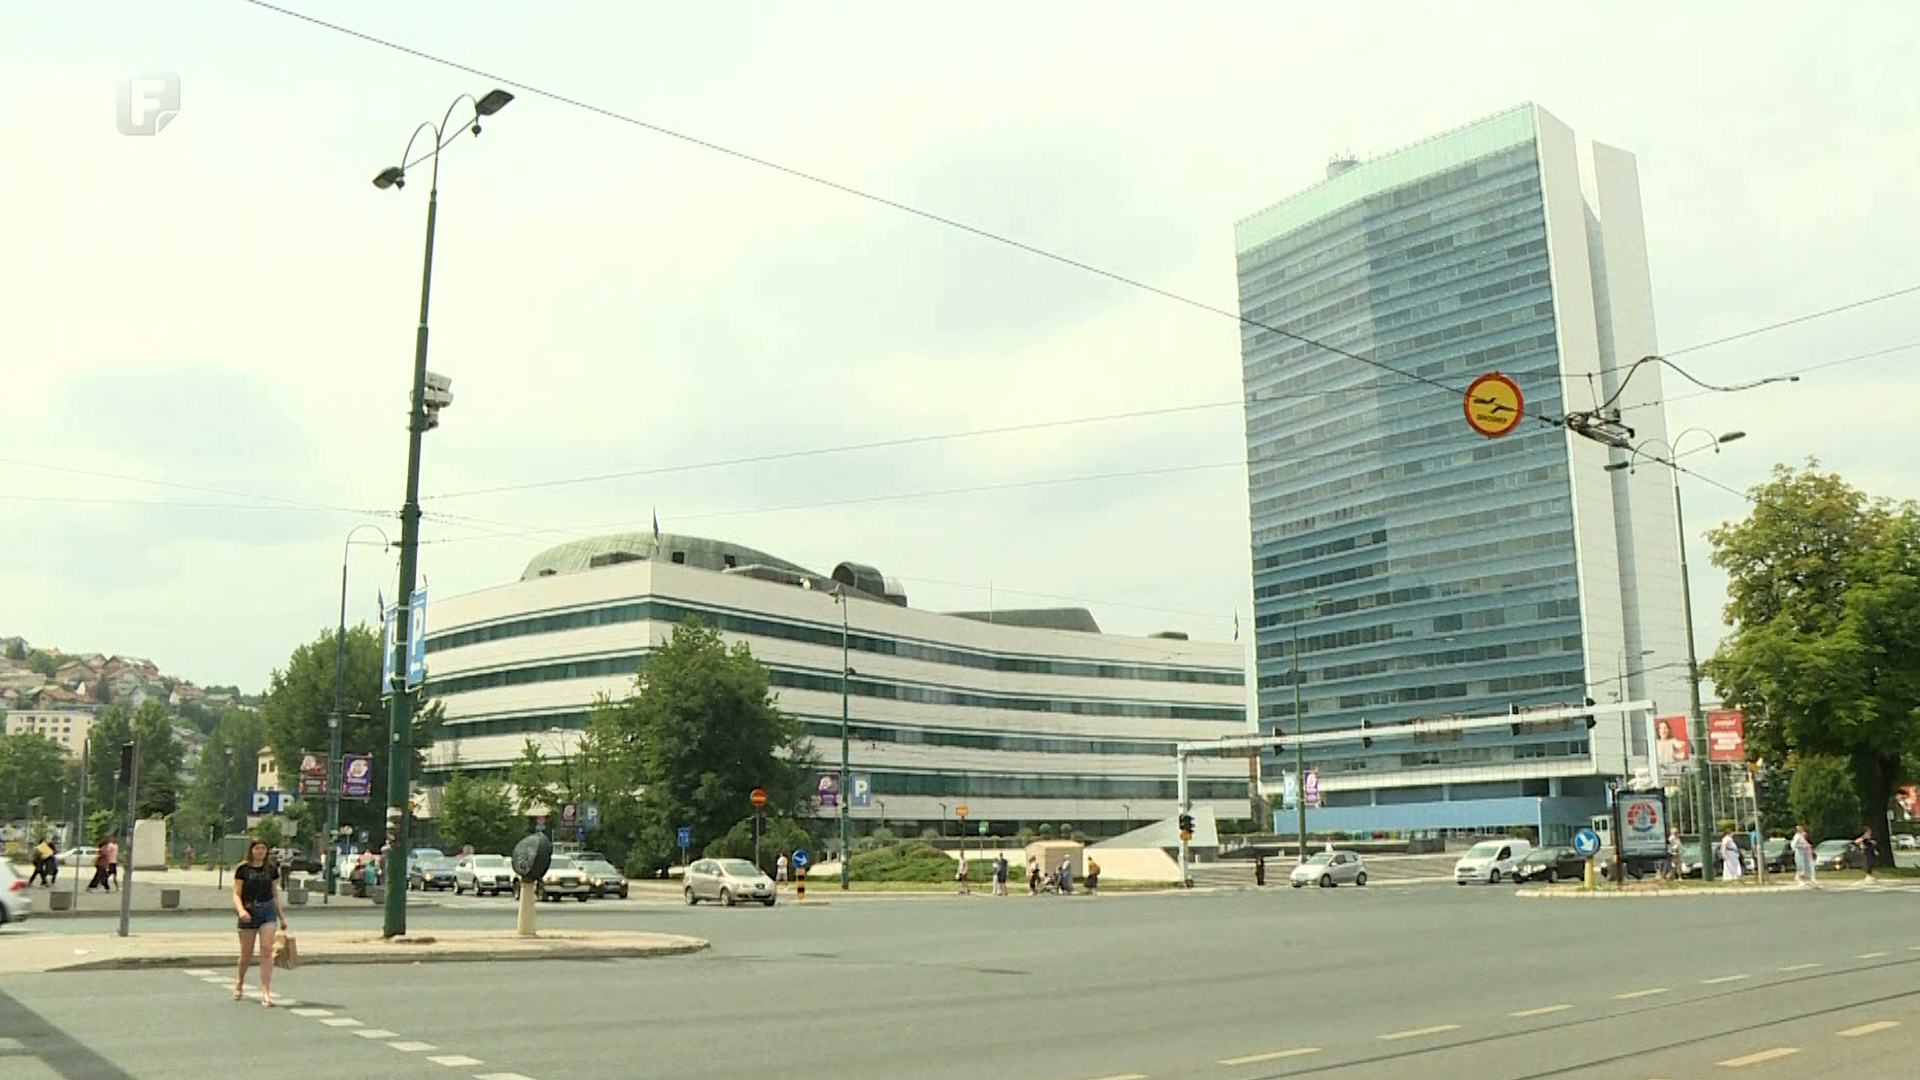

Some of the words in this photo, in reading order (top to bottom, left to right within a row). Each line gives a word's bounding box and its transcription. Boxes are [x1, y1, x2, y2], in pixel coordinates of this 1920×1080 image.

[412, 606, 424, 656] P
[855, 780, 868, 797] P
[252, 792, 269, 812] P
[278, 793, 295, 812] P
[587, 807, 598, 820] P
